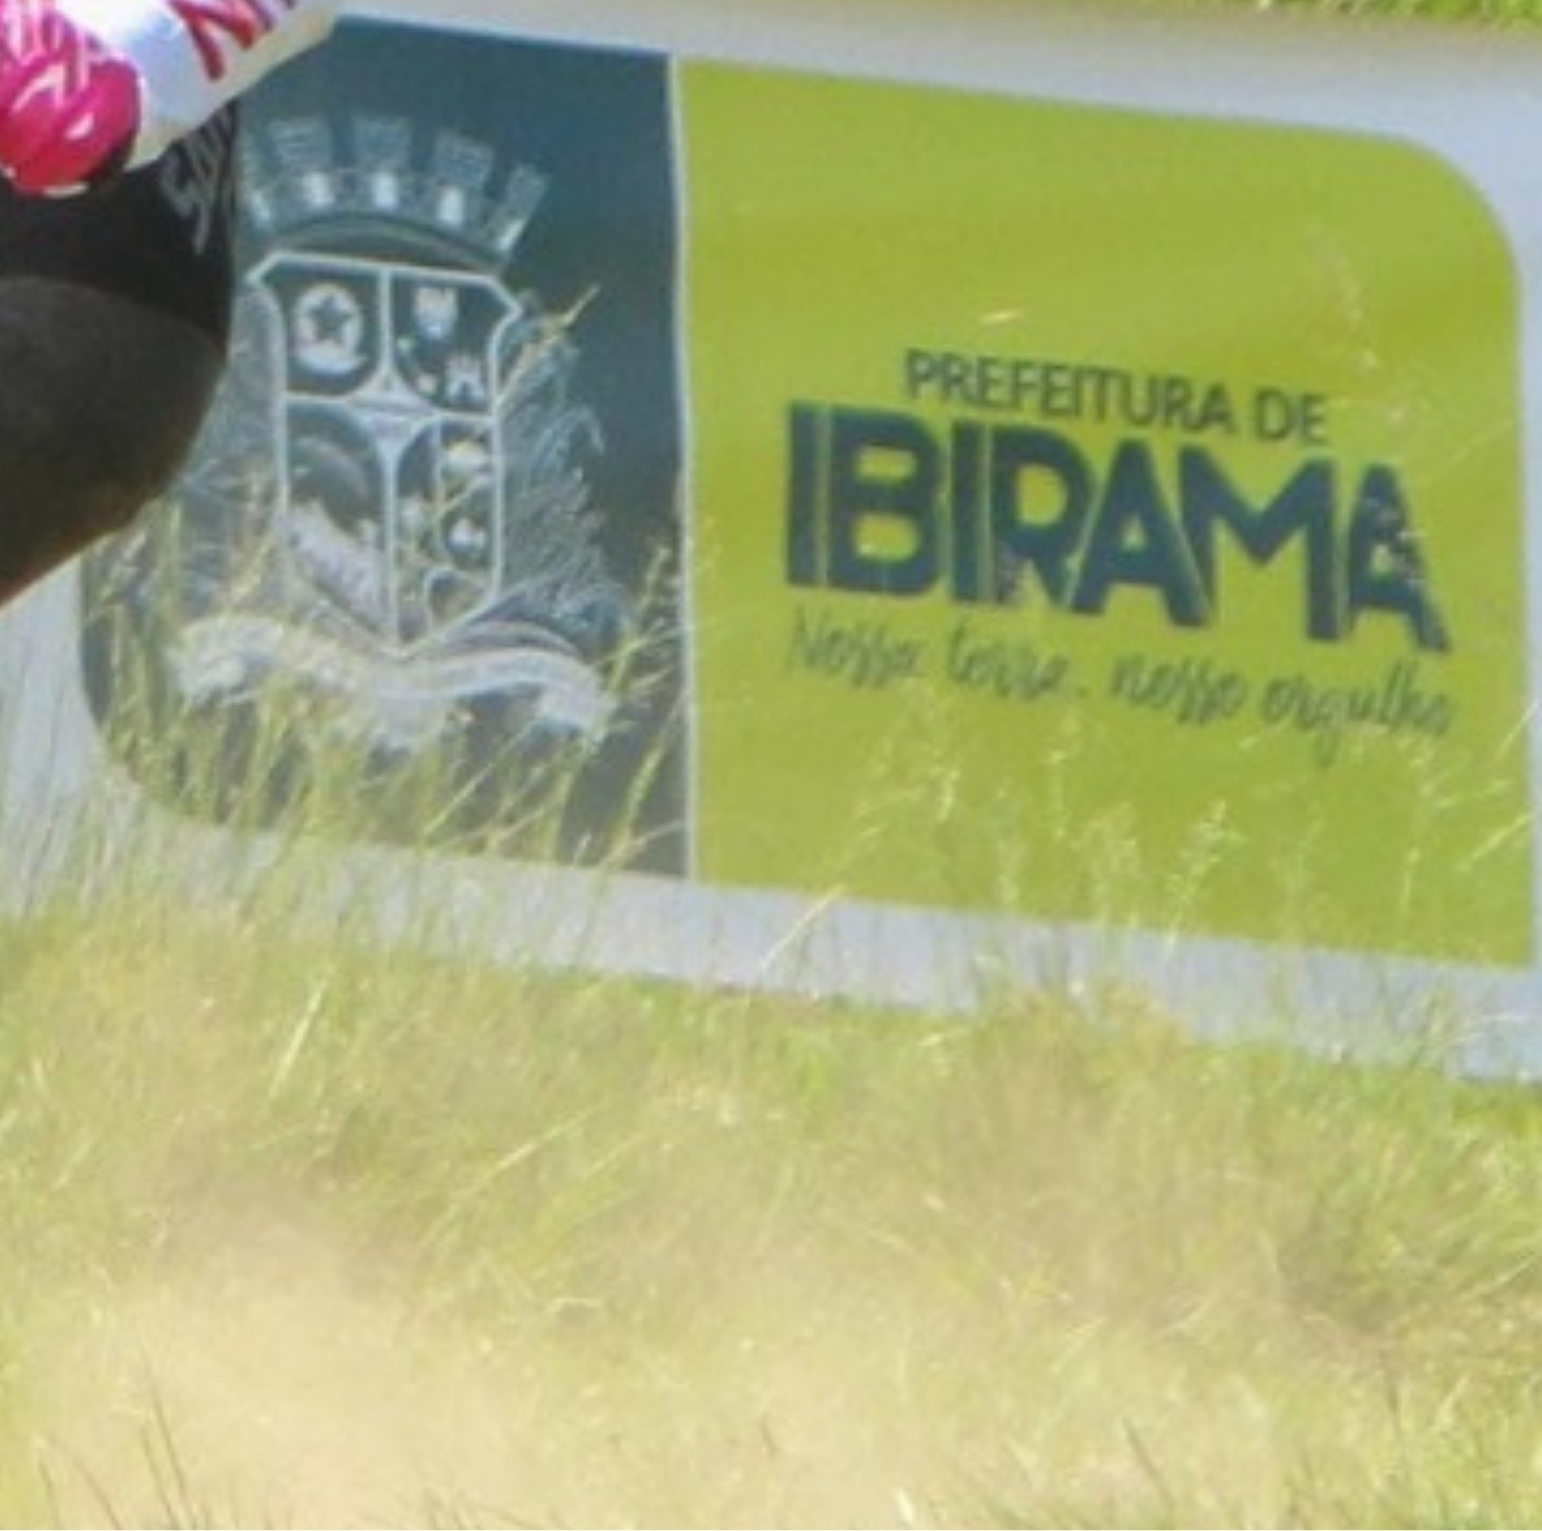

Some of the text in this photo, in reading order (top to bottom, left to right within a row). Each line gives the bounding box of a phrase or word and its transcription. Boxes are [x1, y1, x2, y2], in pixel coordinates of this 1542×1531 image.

[905, 348, 1328, 445] PREFEITURA DE
[785, 401, 1451, 654] IBIRAMA
[1261, 660, 1450, 770] orgulho
